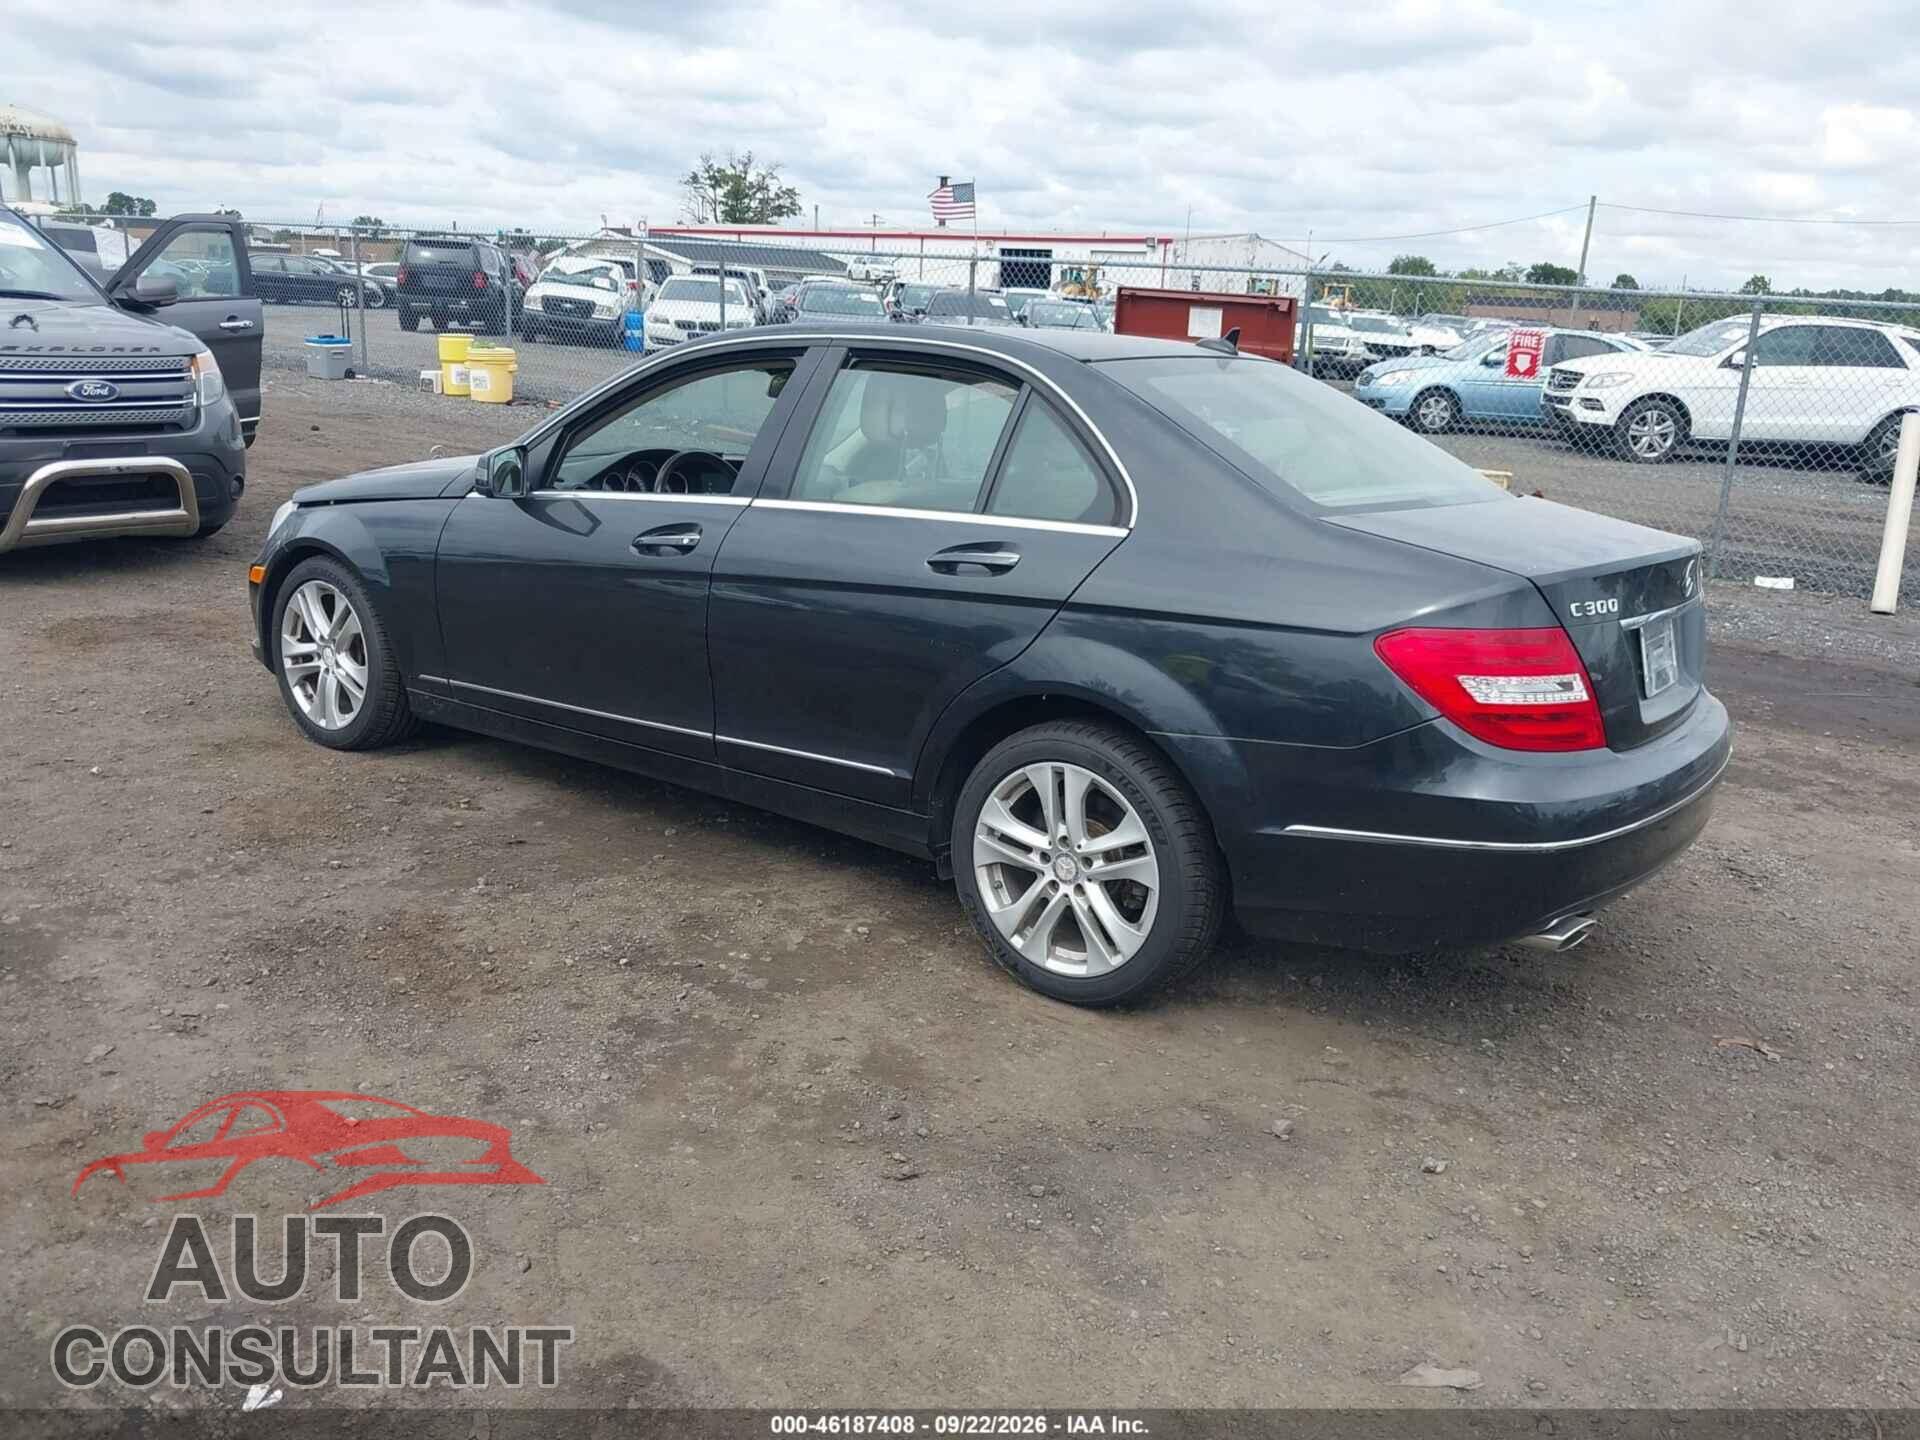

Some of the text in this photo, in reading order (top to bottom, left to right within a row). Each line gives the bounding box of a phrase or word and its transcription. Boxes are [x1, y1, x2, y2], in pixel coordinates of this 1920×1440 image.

[1513, 335, 1539, 348] FIRE
[0, 345, 161, 353] EXPLORER
[80, 383, 110, 396] Ford
